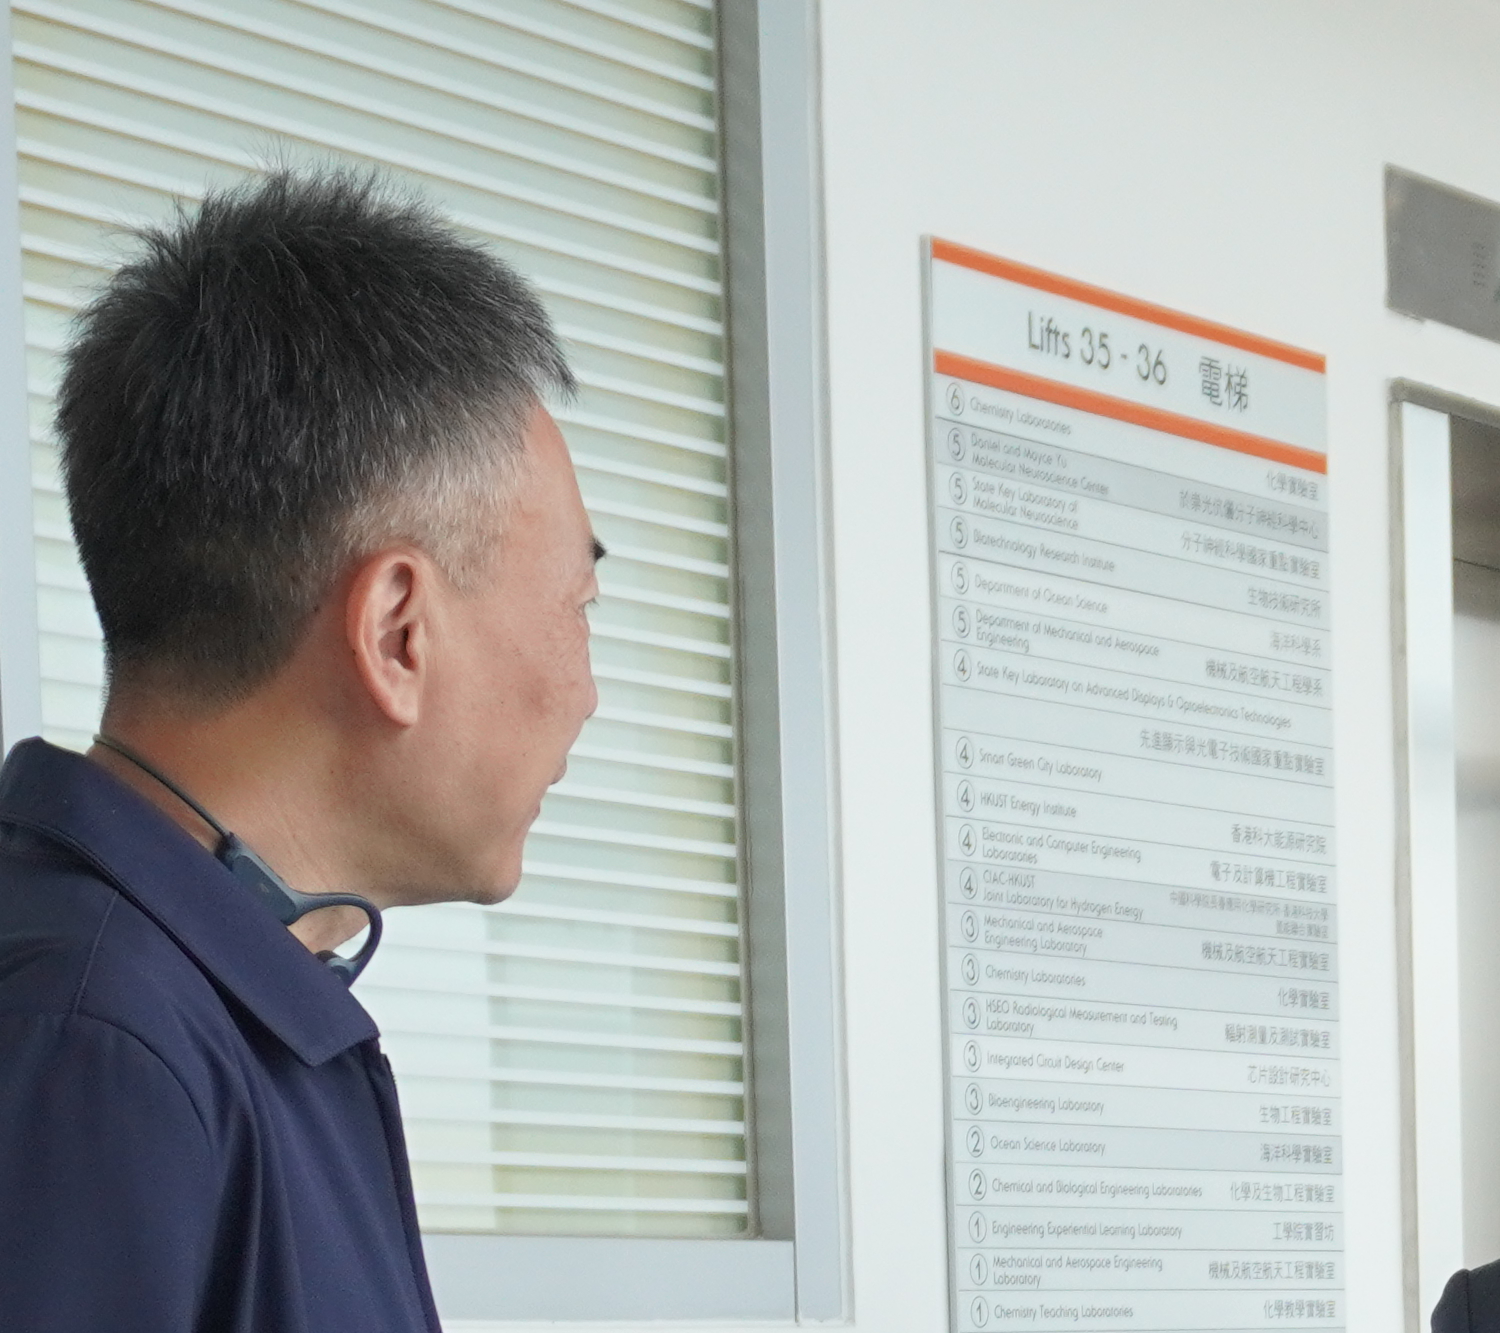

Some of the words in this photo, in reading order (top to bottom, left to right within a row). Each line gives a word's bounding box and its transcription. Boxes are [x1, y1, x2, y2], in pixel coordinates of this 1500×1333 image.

[1027, 311, 1071, 359] Lifts
[1080, 327, 1111, 370] 35
[1137, 343, 1167, 386] 36
[1199, 356, 1248, 412] 電梯
[969, 396, 1014, 424] Chemistry
[1016, 409, 1071, 435] Laboratories
[976, 626, 1031, 655] Engineering
[979, 747, 1005, 765] Smart
[1007, 751, 1035, 769] Green
[1036, 756, 1054, 776] City
[1055, 763, 1102, 783] Laboratory
[980, 792, 1008, 808] HKUST
[1010, 795, 1041, 817] Energy
[1043, 801, 1077, 818] Institute
[982, 826, 1024, 846] Electronic
[1026, 835, 1044, 848] and
[1045, 834, 1089, 854] Computer
[1091, 840, 1141, 864] Engineering
[982, 845, 1038, 864] Laboratories
[982, 888, 1004, 902] Joint
[1006, 891, 1054, 910] Laboratory
[1055, 896, 1068, 909] for
[1070, 898, 1114, 919] Hydrogen
[1114, 901, 1144, 921] Energy
[983, 915, 1034, 931] Mechanical
[1036, 921, 1055, 933] and
[1056, 922, 1103, 939] Aerospace
[984, 930, 1039, 954] Engineering
[1039, 937, 1089, 959] Laboratory
[985, 964, 1029, 985] Chemistry
[1031, 969, 1086, 987] Laboratories
[985, 999, 1010, 1014] HSEO
[1012, 1000, 1066, 1022] Radiological
[1069, 1008, 1127, 1023] Measurement
[1129, 1012, 1147, 1025] and
[1149, 1011, 1178, 1031] Testing
[986, 1016, 1036, 1039] Laboratory
[987, 1052, 1034, 1069] Integrated
[1036, 1053, 1062, 1069] Circuit
[1064, 1055, 1093, 1074] Design
[1096, 1056, 1124, 1072] Center
[988, 1092, 1056, 1114] Bioengineering
[1058, 1097, 1104, 1116] Laboratory
[990, 1135, 1021, 1150] Ocean
[1023, 1136, 1057, 1152] Science
[1058, 1139, 1106, 1156] Laboratory
[991, 1177, 1034, 1193] Chemical
[1035, 1181, 1053, 1194] and
[1055, 1179, 1098, 1198] Biological
[1099, 1180, 1150, 1199] Engineering
[1151, 1184, 1203, 1197] Laboratories
[992, 1220, 1045, 1239] Engineering
[1046, 1220, 1097, 1238] Experiential
[1099, 1223, 1136, 1240] Learning
[1137, 1223, 1182, 1239] Laboratory
[992, 1255, 1043, 1268] Mechanical
[1045, 1255, 1063, 1268] and
[1065, 1256, 1111, 1271] Aerospace
[1113, 1254, 1163, 1272] Engineering
[993, 1272, 1043, 1290] Laboratory
[993, 1304, 1037, 1322] Chemistry
[1039, 1304, 1079, 1322] Teaching
[1081, 1305, 1134, 1318] Laboratories
